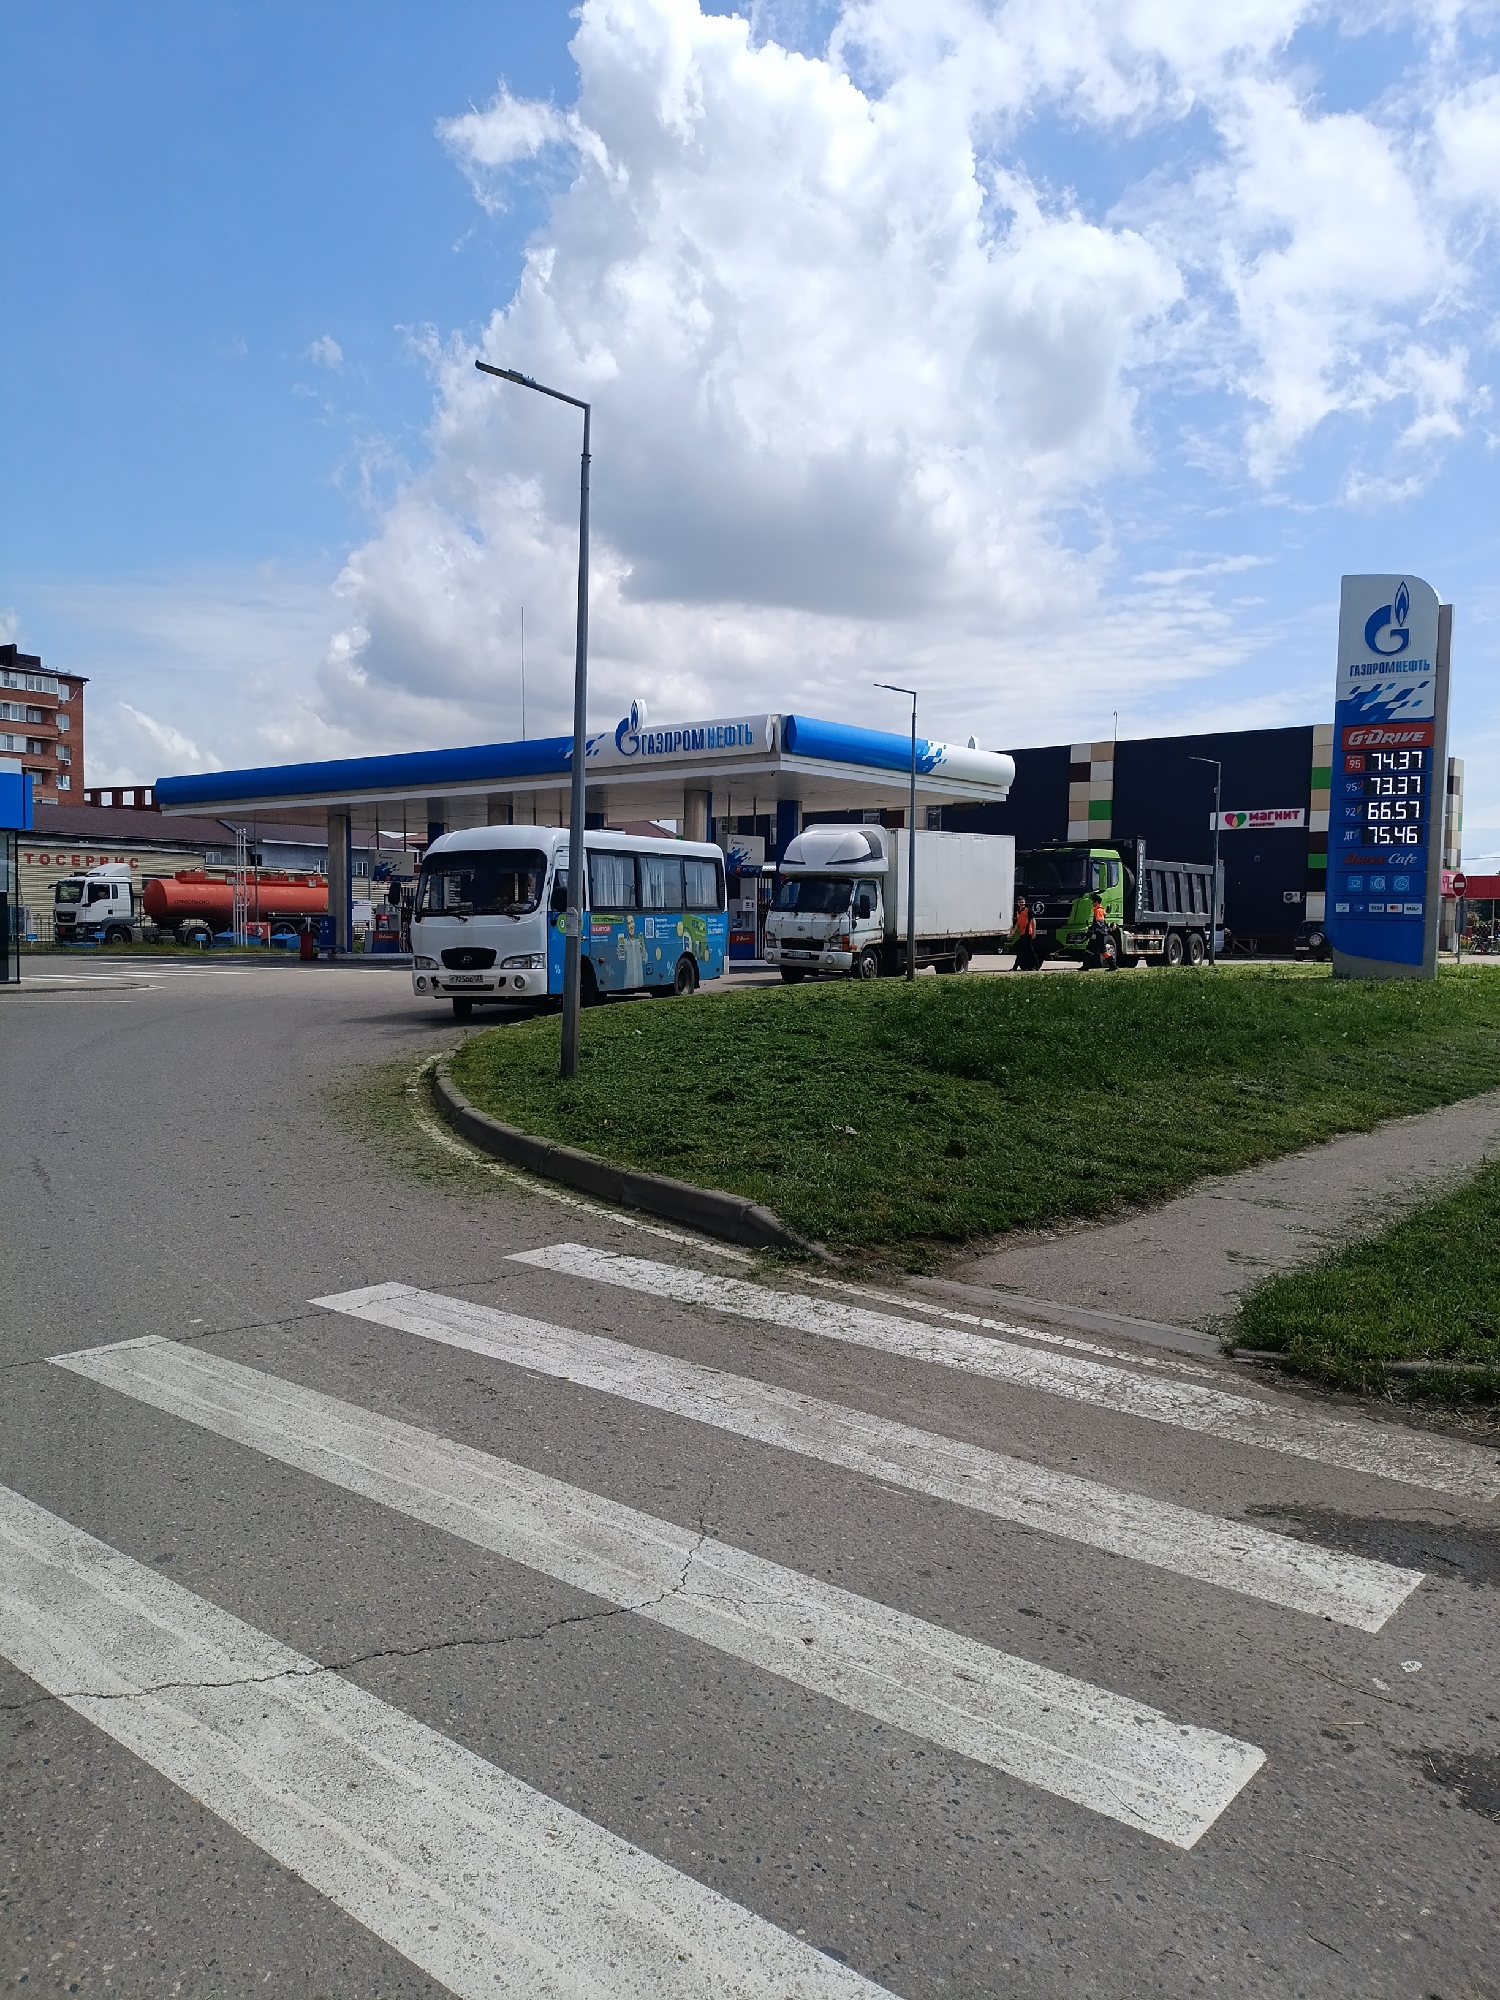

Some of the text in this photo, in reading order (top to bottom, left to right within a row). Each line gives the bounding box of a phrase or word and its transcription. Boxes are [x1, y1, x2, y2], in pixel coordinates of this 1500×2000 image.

[1349, 659, 1431, 677] ГАЗПРОМНЕФТЬ
[641, 723, 754, 756] ГАЗПРОМНЕФТЬ
[1349, 751, 1423, 770] 95 74.37
[1346, 775, 1421, 796] 95 73.37
[1345, 800, 1420, 820] 92 66.57
[1343, 825, 1418, 845] ДТ 75.46
[1388, 852, 1418, 866] Cafe
